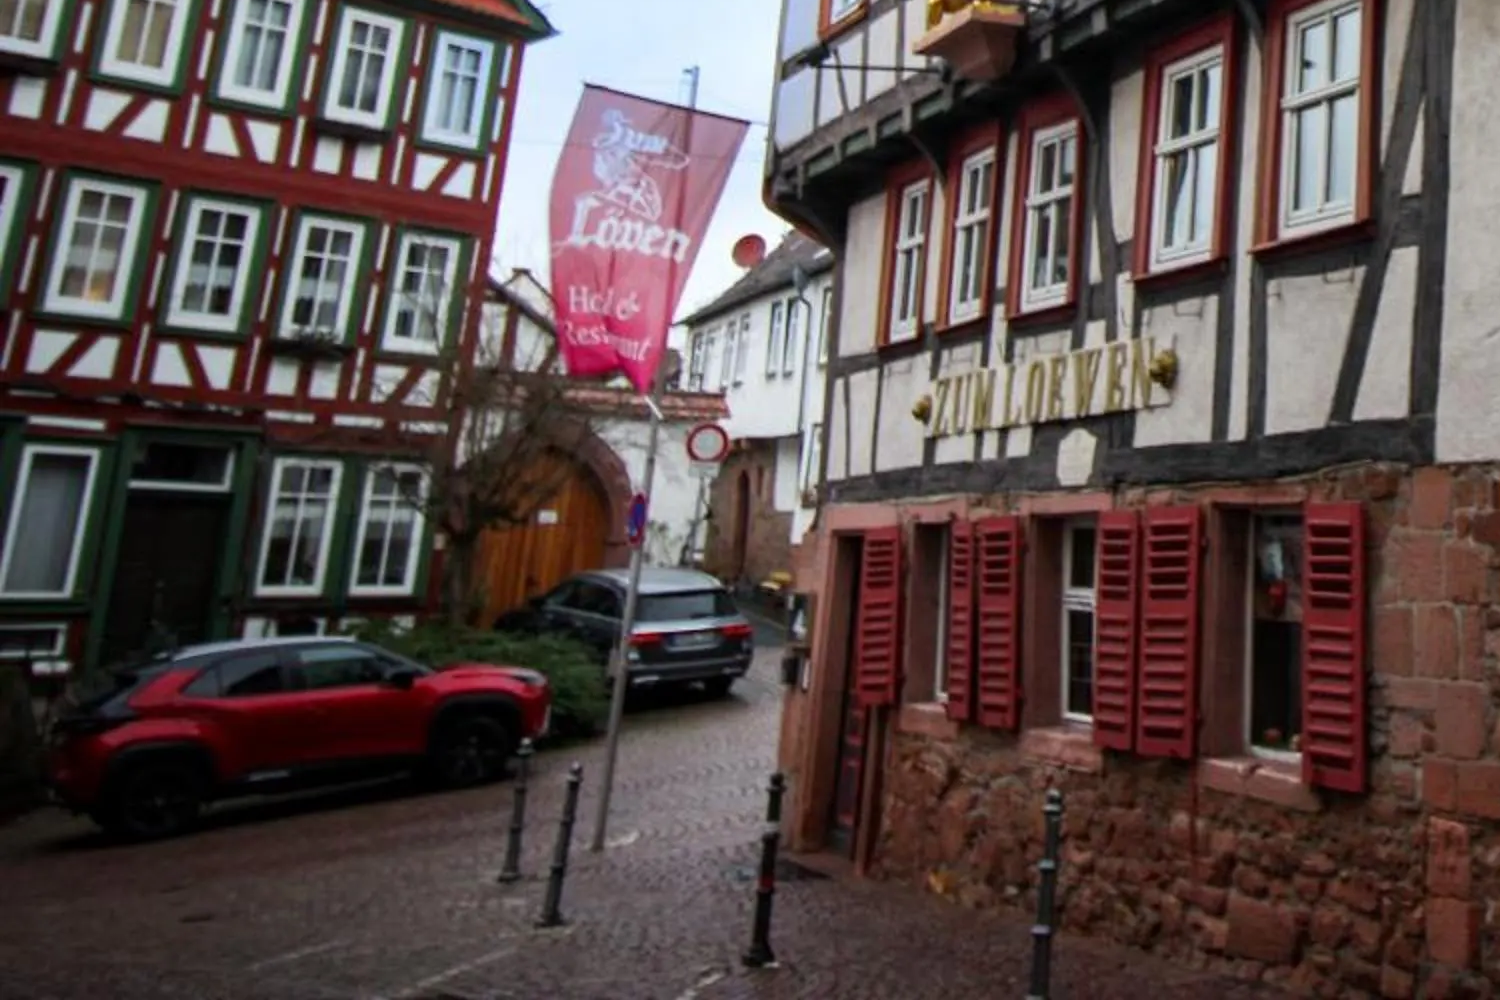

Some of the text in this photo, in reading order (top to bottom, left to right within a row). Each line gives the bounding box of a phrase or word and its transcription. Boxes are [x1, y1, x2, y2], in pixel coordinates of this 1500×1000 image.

[565, 196, 691, 264] Löwen
[932, 337, 1155, 438] ZUM LOEWEN
